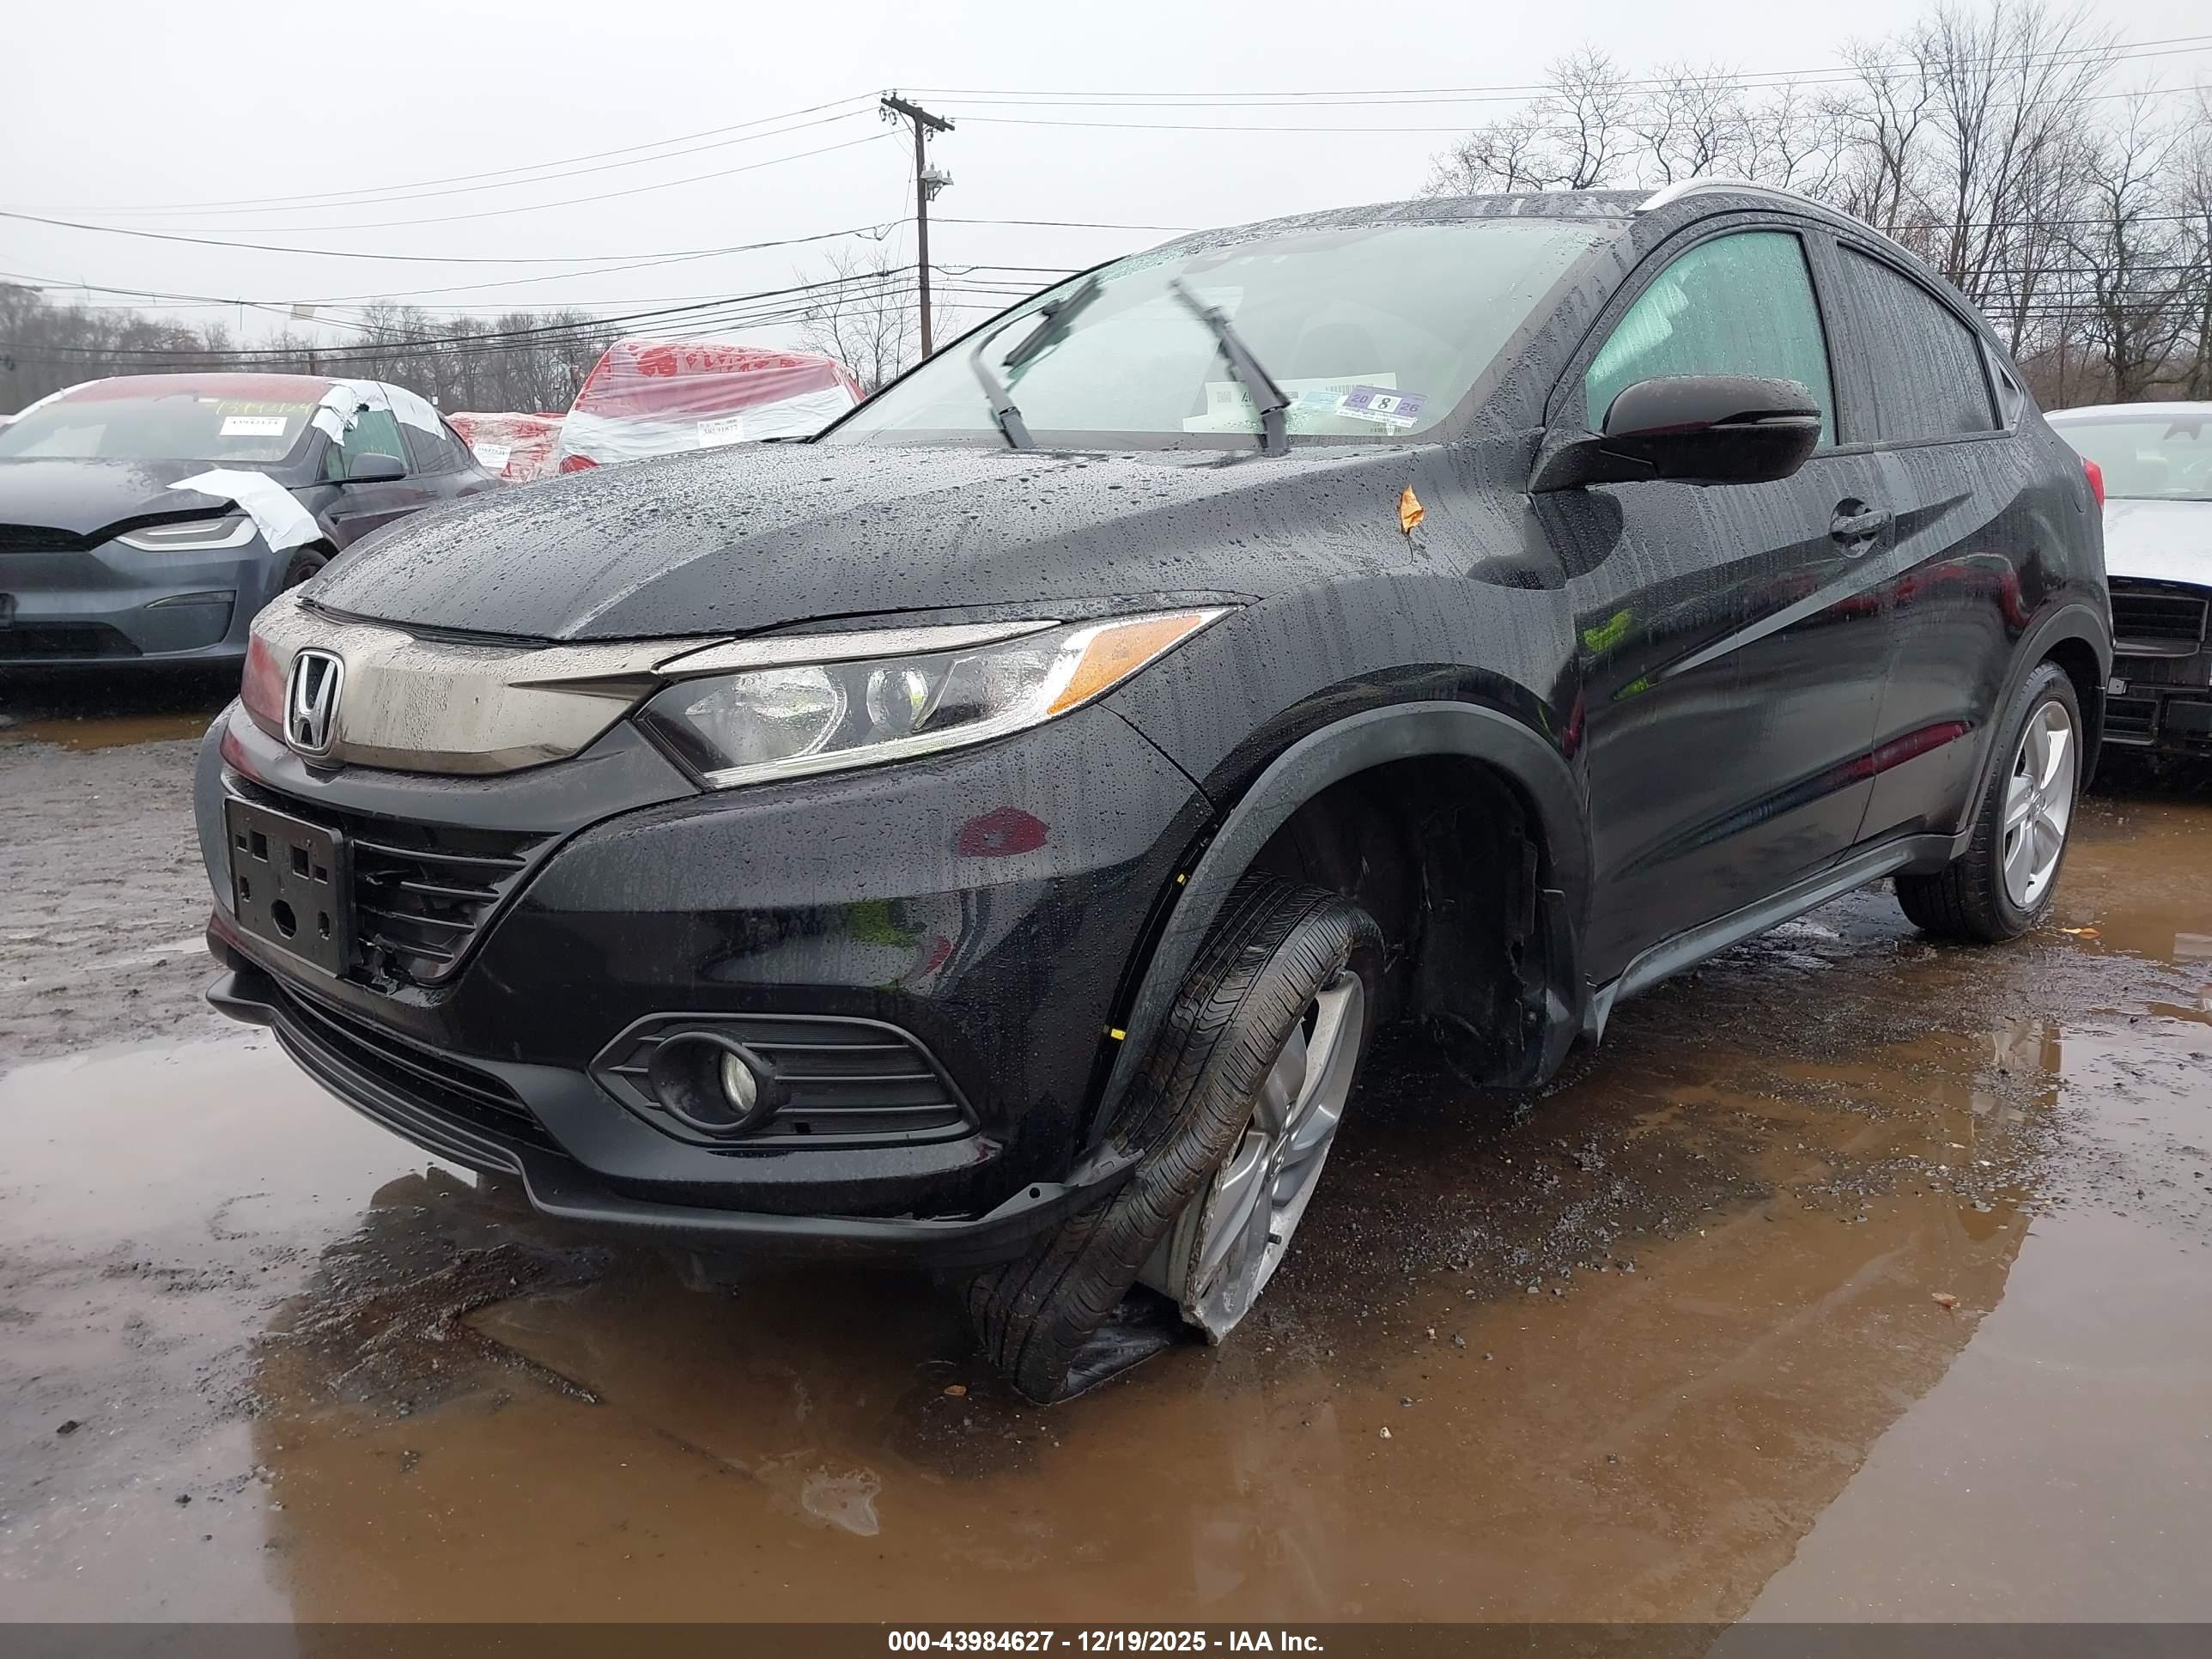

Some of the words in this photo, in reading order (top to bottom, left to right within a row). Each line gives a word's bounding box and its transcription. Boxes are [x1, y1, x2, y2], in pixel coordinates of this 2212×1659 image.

[1352, 395, 1369, 404] 20
[1378, 398, 1391, 410] 8
[1400, 402, 1420, 412] 26
